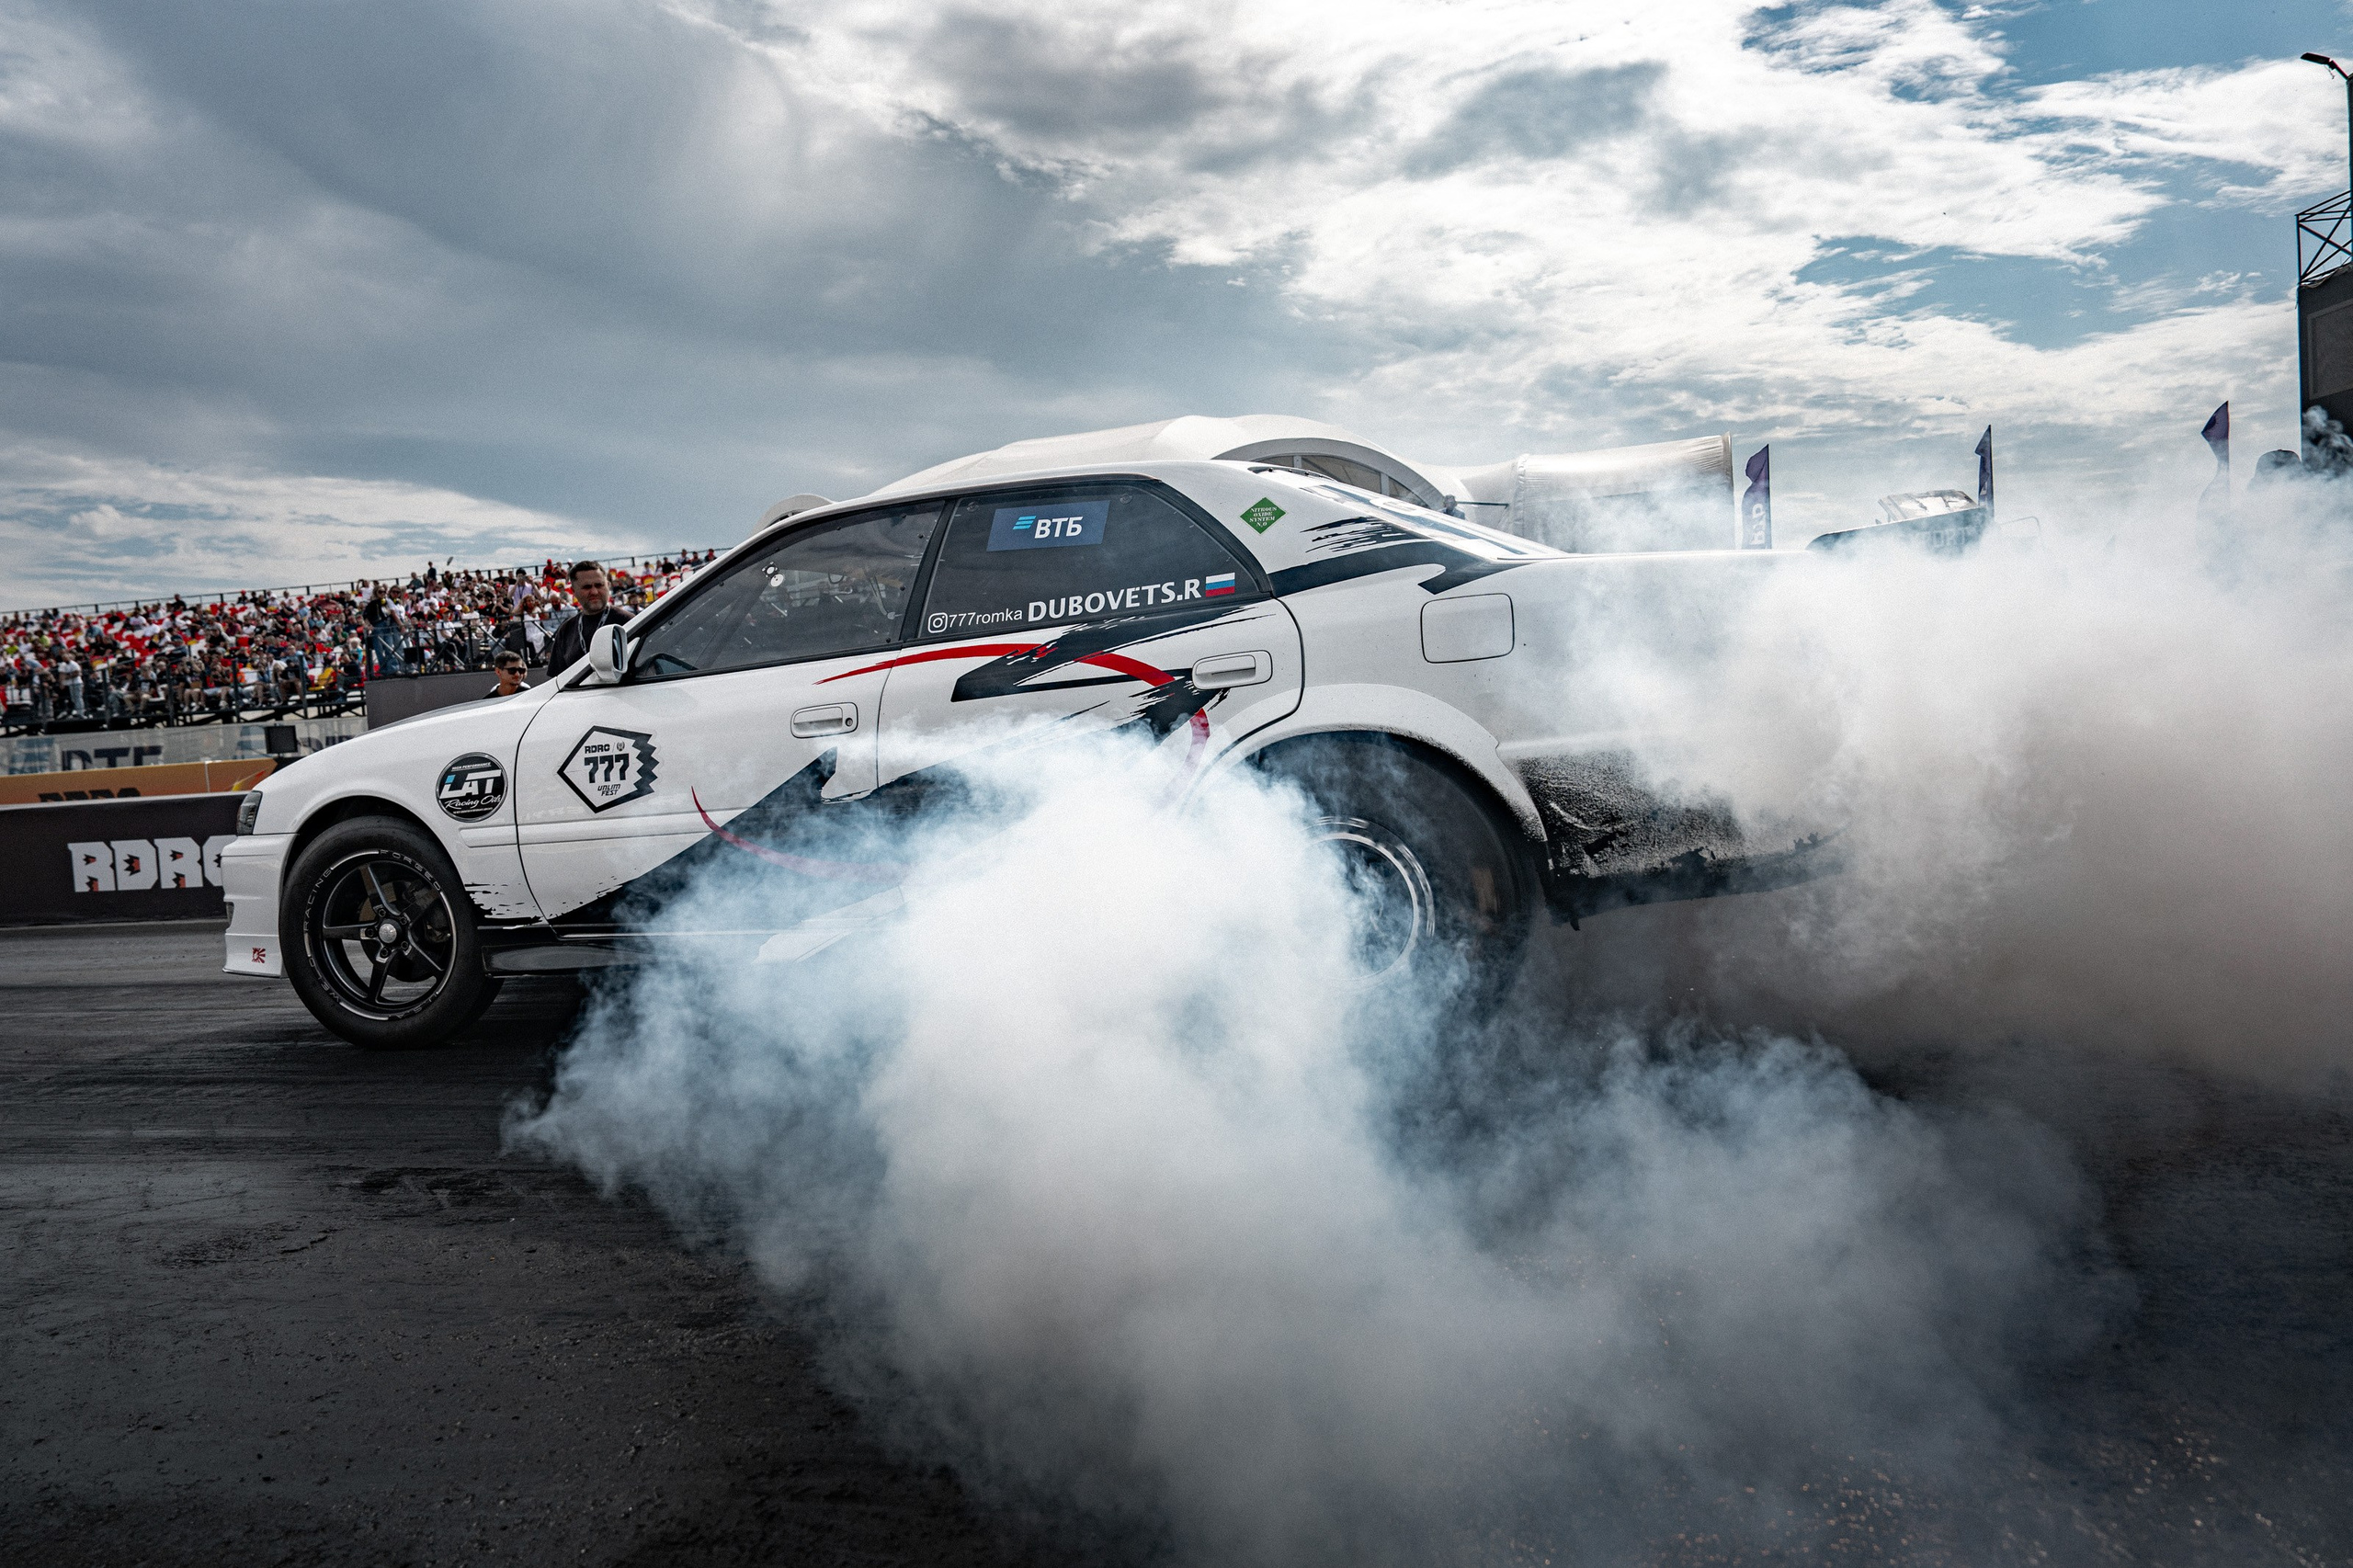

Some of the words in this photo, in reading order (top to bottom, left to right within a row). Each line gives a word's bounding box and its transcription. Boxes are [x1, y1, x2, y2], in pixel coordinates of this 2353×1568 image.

[1034, 516, 1084, 539] ВТБ
[949, 608, 1023, 629] 777romka
[1028, 578, 1201, 622] DUBOVETS.R
[585, 744, 610, 754] RDRC
[584, 753, 630, 783] 777
[439, 769, 502, 799] LAT
[444, 798, 480, 809] Racing
[380, 849, 441, 892] FORGED
[303, 869, 332, 932] RACING
